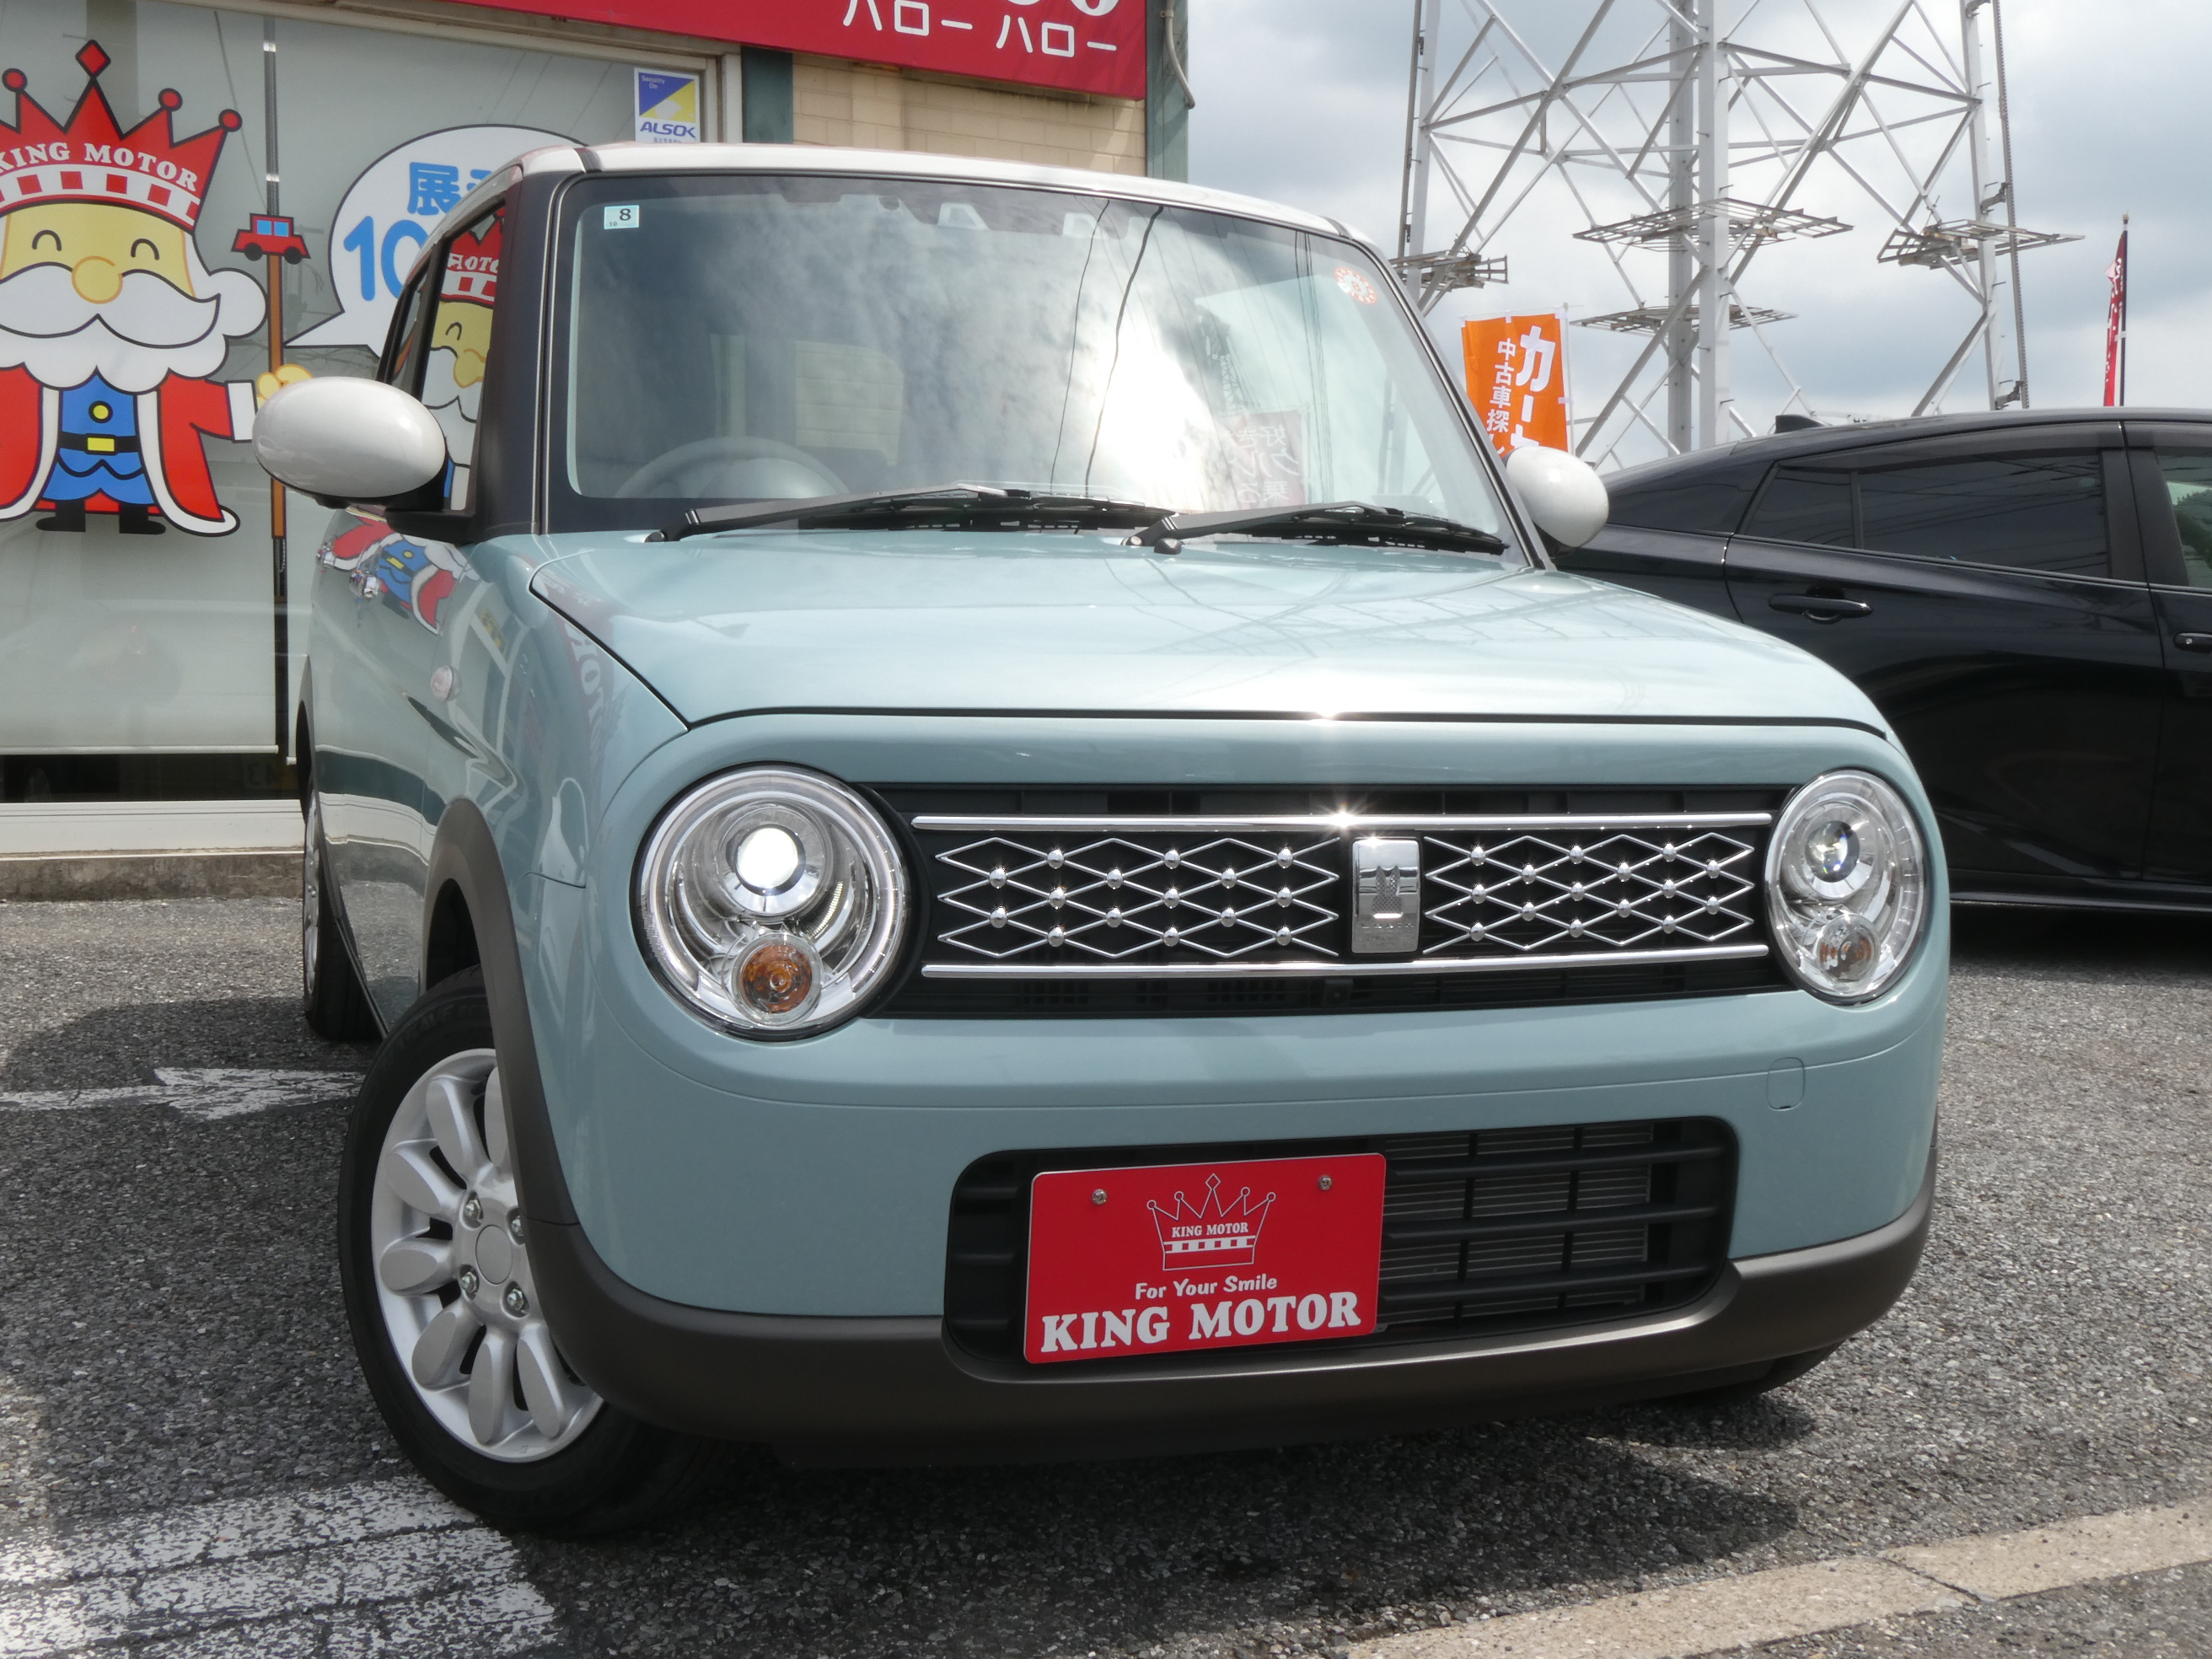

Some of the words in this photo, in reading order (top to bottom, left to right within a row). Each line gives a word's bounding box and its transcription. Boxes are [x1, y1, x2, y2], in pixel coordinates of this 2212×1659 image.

[843, 0, 973, 36] ハロー
[996, 14, 1118, 57] ハロー
[640, 121, 696, 139] ALSOK
[83, 142, 199, 191] MOTOR
[406, 161, 493, 217] 展
[619, 208, 631, 221] 8
[1171, 1225, 1203, 1238] KING
[1206, 1221, 1249, 1236] MOTOR
[1135, 1282, 1168, 1300] For
[1173, 1278, 1219, 1297] Your
[1222, 1273, 1279, 1293] Smile
[1040, 1306, 1171, 1353] KING
[1188, 1291, 1362, 1340] MOTOR
